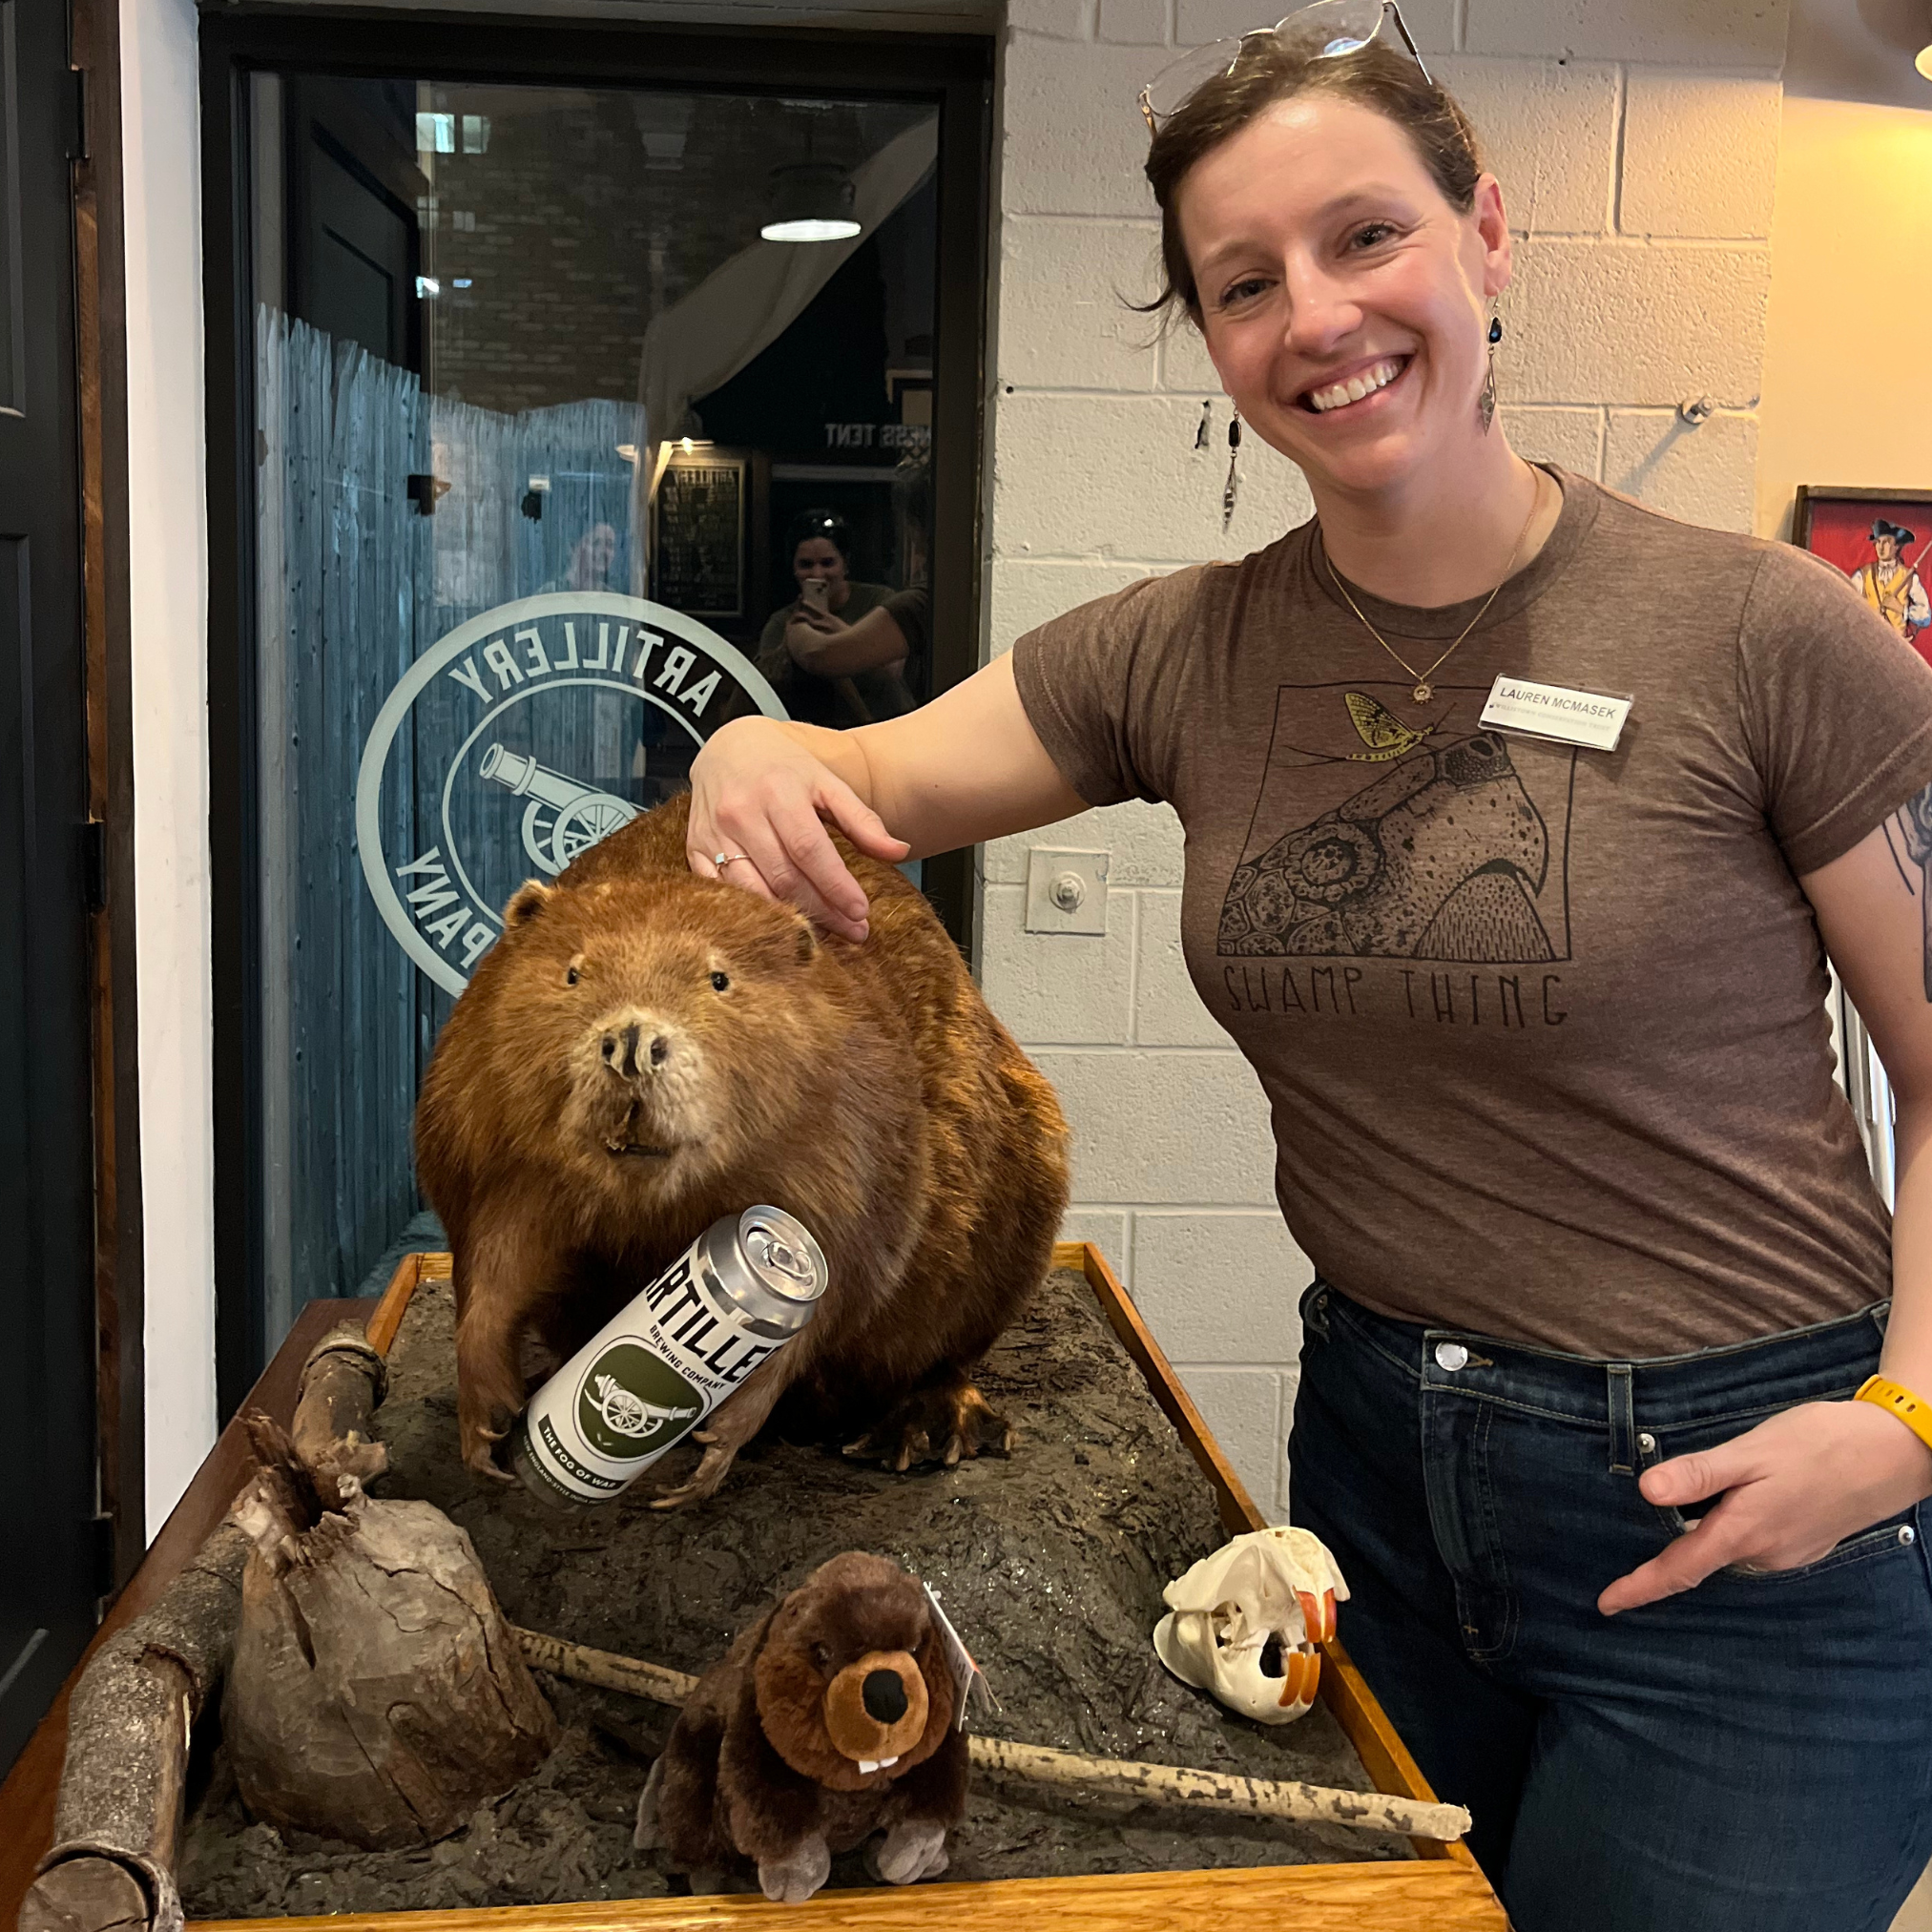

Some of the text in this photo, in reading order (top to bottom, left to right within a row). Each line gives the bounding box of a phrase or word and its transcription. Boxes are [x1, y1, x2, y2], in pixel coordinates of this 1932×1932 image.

[1500, 687, 1617, 719] LAUREN MCMASEK
[1223, 966, 1568, 1029] SWAMP THING
[646, 1256, 782, 1384] RTILLE
[650, 1324, 725, 1390] BREWING COMPANY
[529, 1451, 570, 1496] ENGLAND-STYLE
[543, 1426, 616, 1488] THE FOG OF WAR
